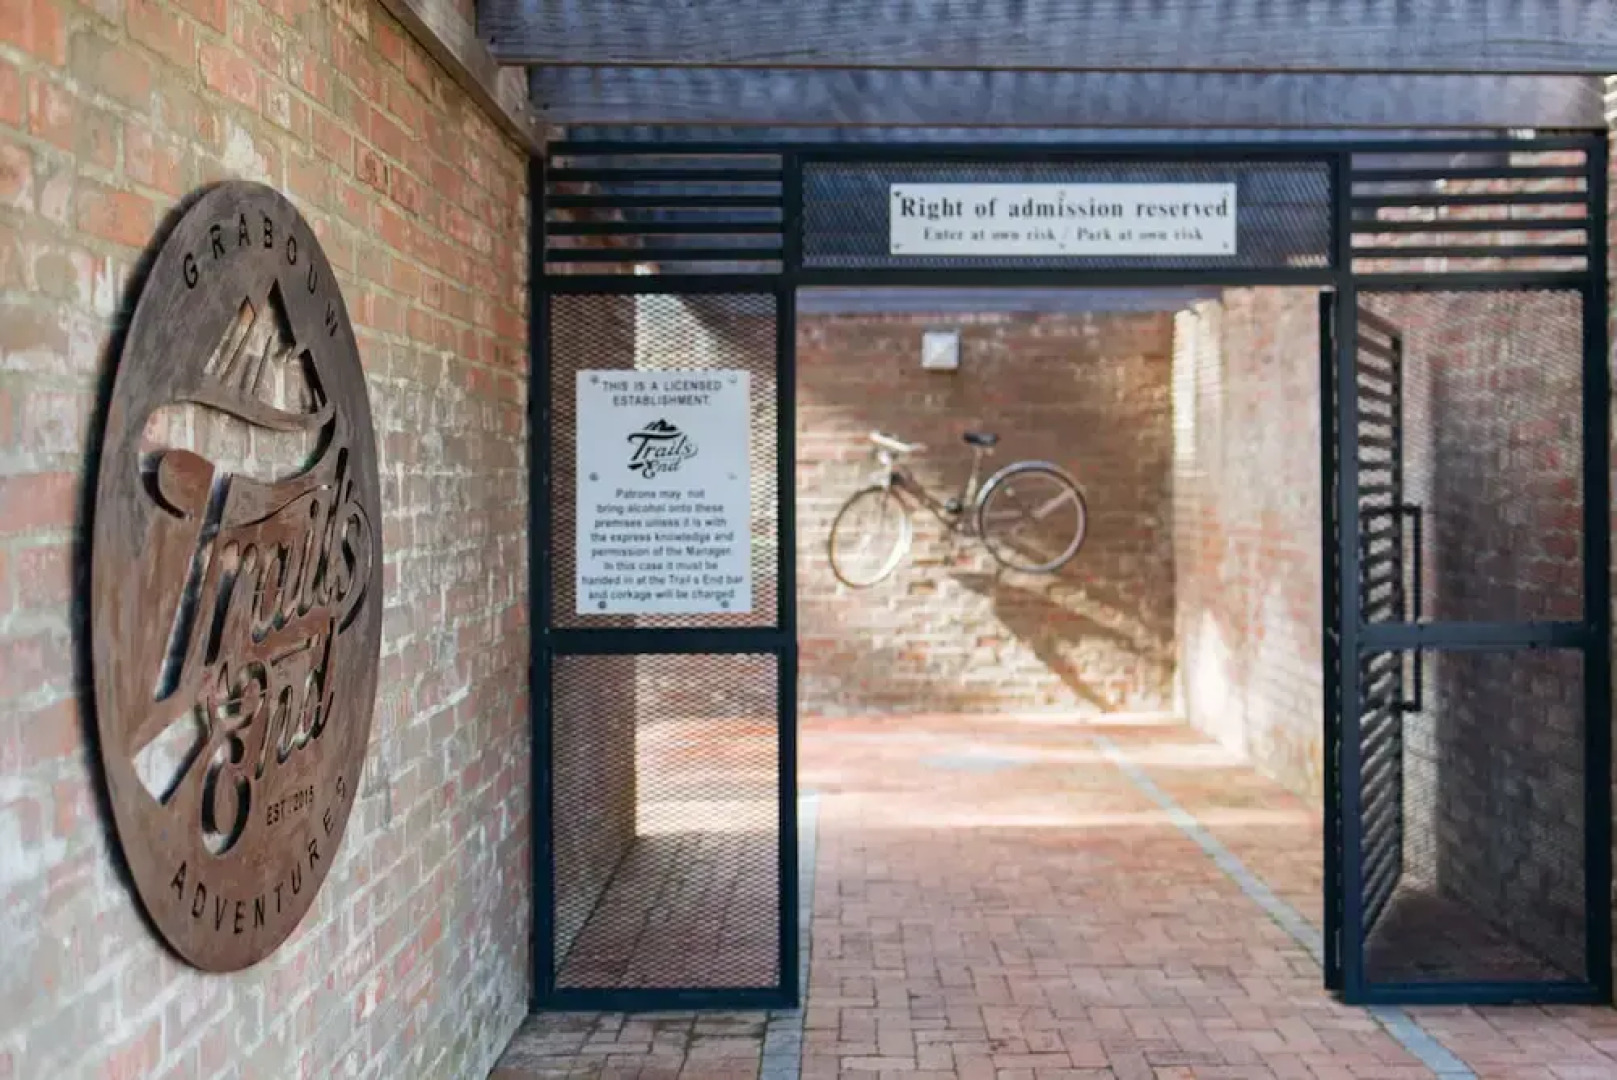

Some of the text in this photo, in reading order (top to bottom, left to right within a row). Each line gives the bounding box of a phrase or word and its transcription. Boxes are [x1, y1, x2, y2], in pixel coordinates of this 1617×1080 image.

[900, 196, 1228, 221] Right of admission reserved
[923, 227, 964, 241] Enter
[970, 228, 985, 241] at
[991, 230, 1019, 241] own
[1027, 227, 1056, 241] risk
[1076, 227, 1111, 241] Park
[1118, 228, 1133, 241] at
[1139, 230, 1167, 241] own
[1174, 227, 1203, 241] risk
[183, 213, 339, 337] GRABOUW
[602, 380, 722, 391] THIS IS A LICENSED
[642, 458, 682, 479] End
[616, 488, 705, 501] Patrons may not
[597, 503, 724, 515] bring alcohol onto these
[594, 518, 727, 528] premises unless it is with
[590, 531, 735, 544] the express knowledge and
[591, 547, 649, 559] permission
[653, 546, 664, 556] of
[666, 547, 682, 556] the
[603, 561, 718, 570] In this case it must be
[581, 576, 621, 585] handed
[637, 576, 647, 584] at
[649, 576, 666, 585] the
[702, 575, 724, 585] End
[726, 576, 744, 585] bar
[588, 590, 608, 600] and
[610, 590, 652, 602] corkage
[655, 590, 674, 598] will
[676, 590, 688, 598] be
[170, 775, 347, 936] ADVENTURES
